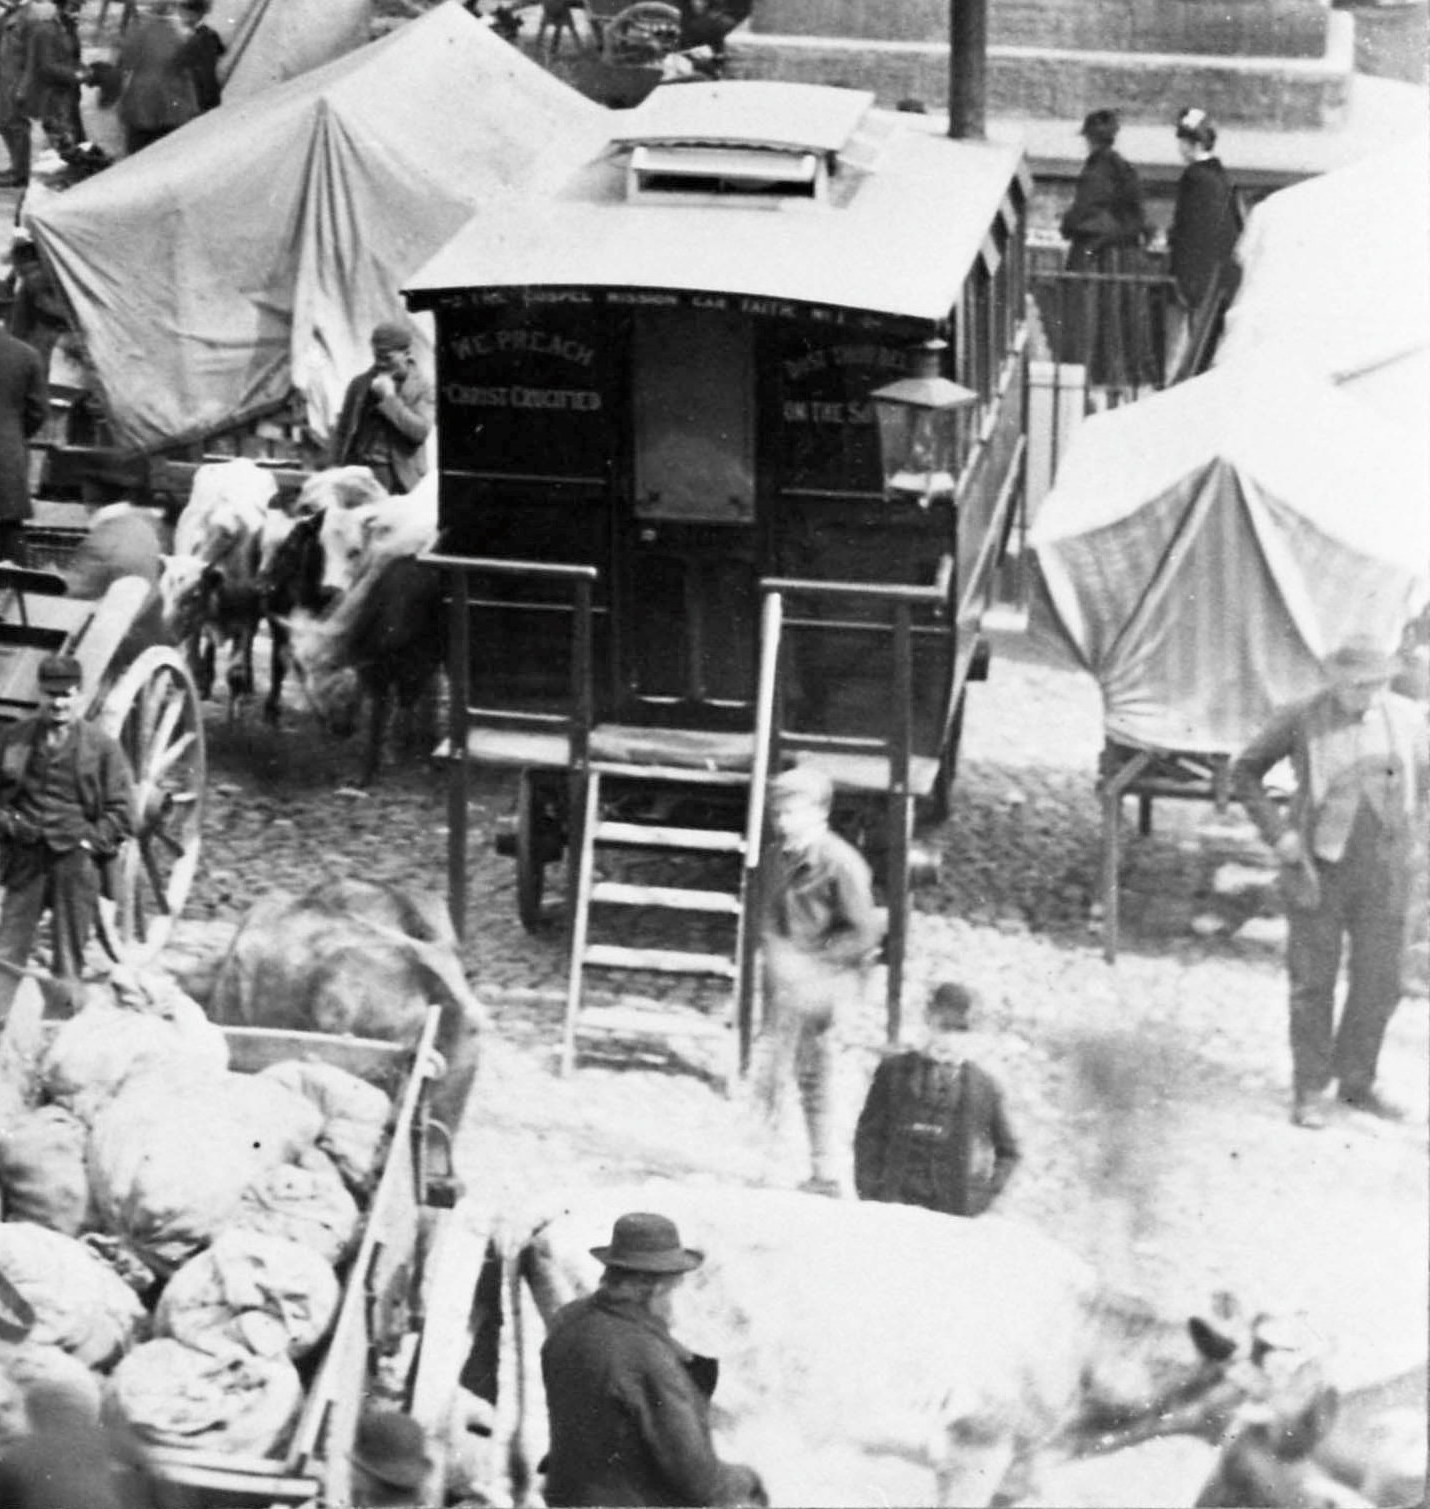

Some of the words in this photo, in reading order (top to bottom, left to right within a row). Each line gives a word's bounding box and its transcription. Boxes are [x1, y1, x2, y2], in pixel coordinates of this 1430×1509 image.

[450, 333, 491, 361] WE
[496, 330, 595, 366] PREACH
[446, 383, 509, 407] CHRIST
[510, 385, 602, 411] CRUCIFIED
[783, 400, 808, 422] ON
[811, 401, 844, 424] THE
